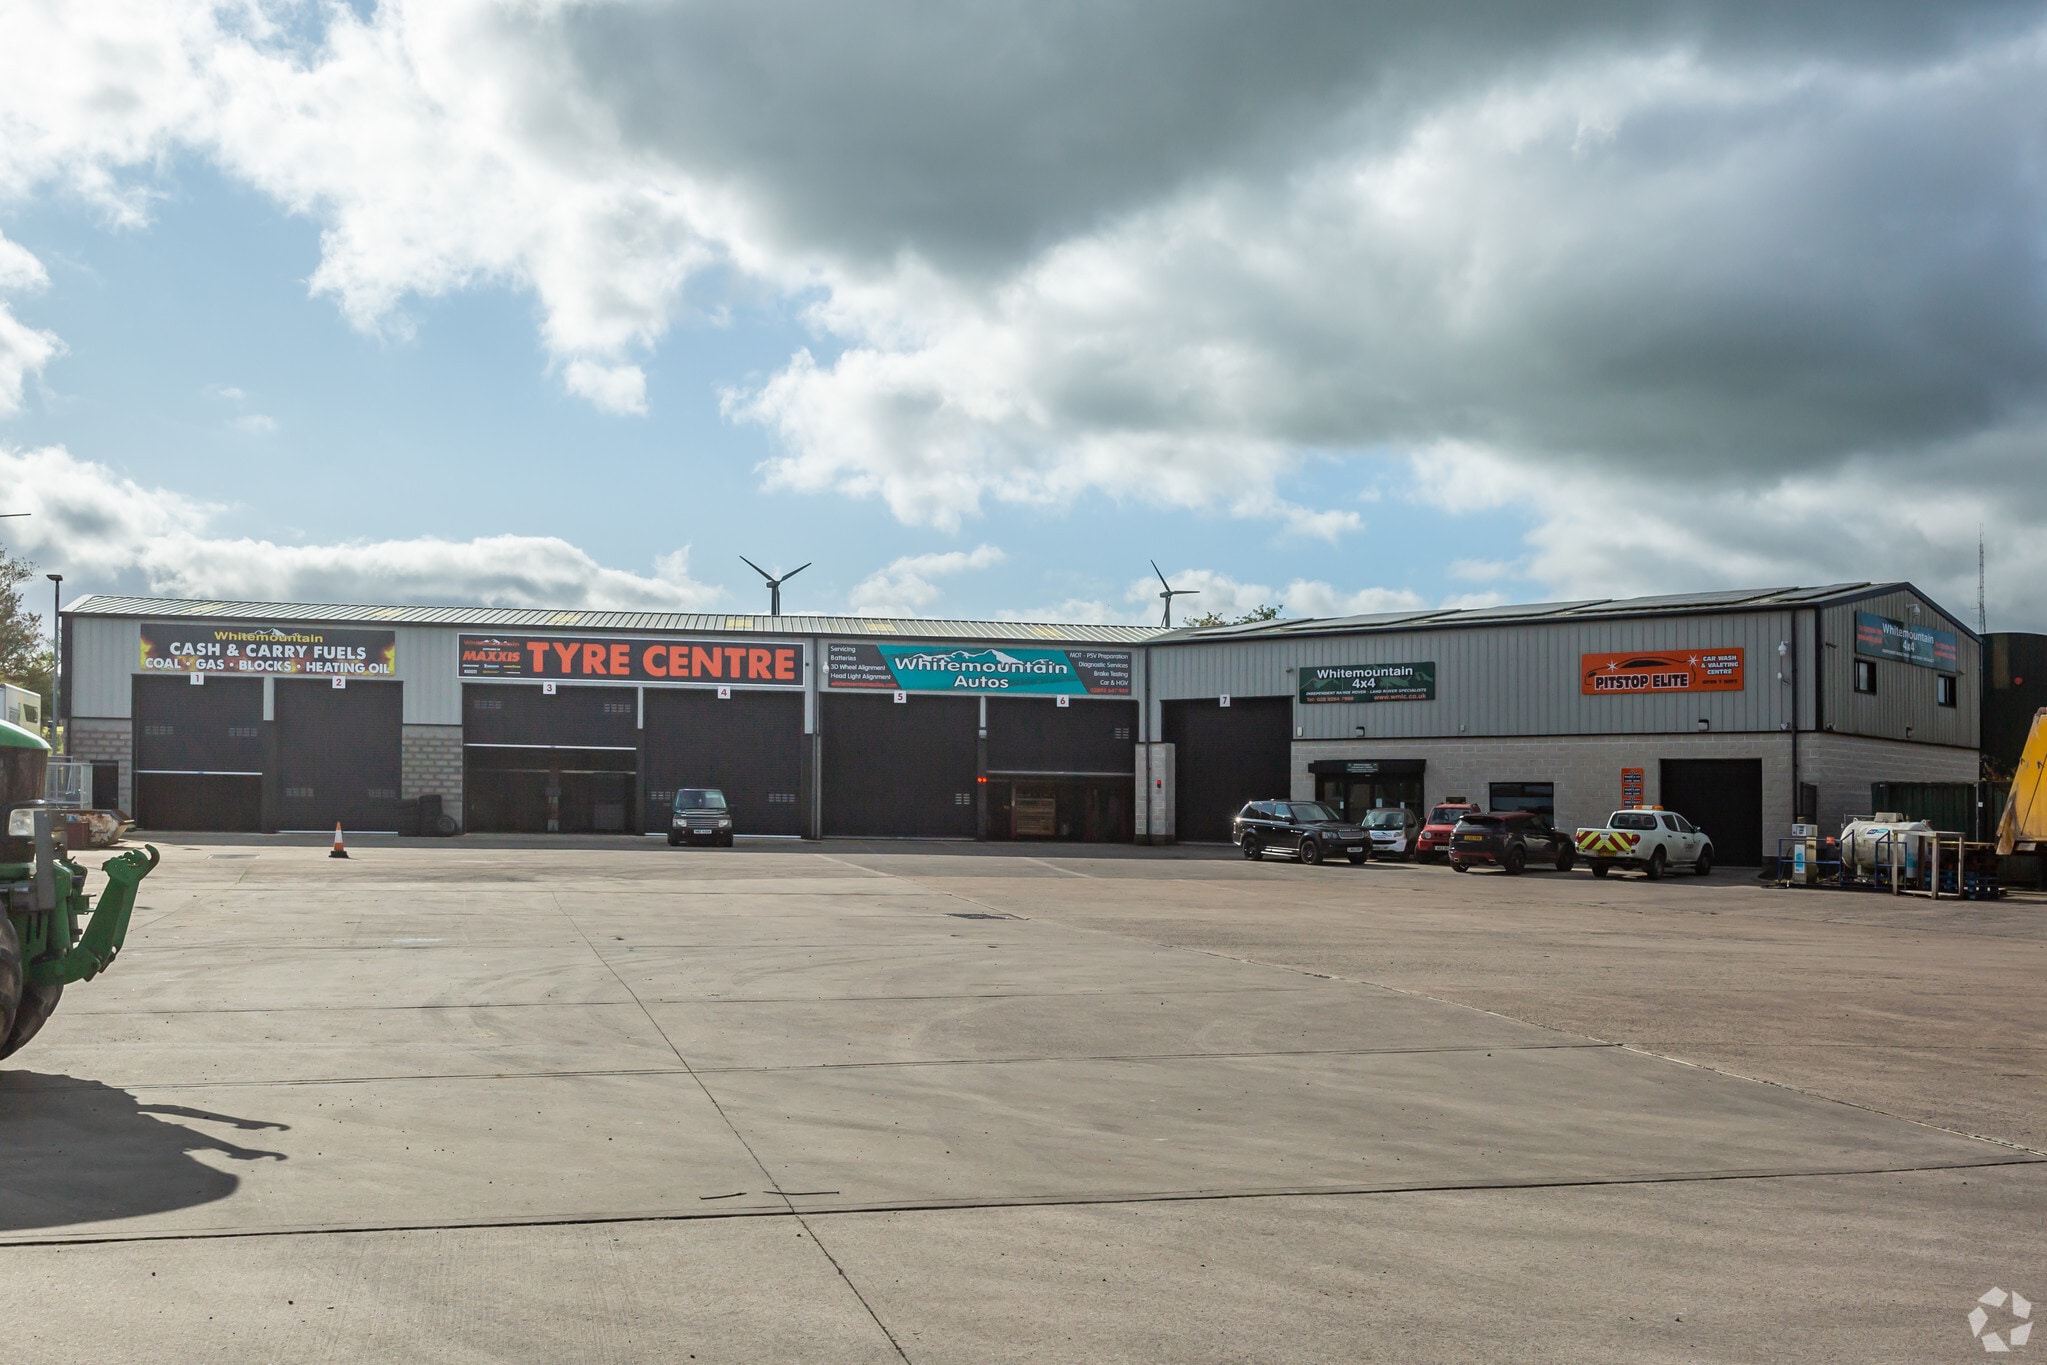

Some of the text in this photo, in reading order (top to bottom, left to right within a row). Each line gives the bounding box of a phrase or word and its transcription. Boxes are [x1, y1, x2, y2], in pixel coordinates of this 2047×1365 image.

[214, 631, 324, 643] Whitemountain
[1882, 623, 1934, 645] Whitemountain
[169, 642, 367, 660] CASH & CARRY FUELS
[830, 645, 856, 653] Servicing
[1902, 640, 1915, 653] 4x4
[462, 650, 521, 662] MAXXIS
[526, 641, 796, 680] TYRE CENTRE
[145, 657, 391, 674] COAL GAS BLOCKS HEATING OIL
[858, 664, 886, 672] Alignment
[894, 657, 1068, 675] Whitemountain
[1078, 661, 1106, 669] Diagnostic
[1317, 666, 1413, 679] Whitemountain
[336, 678, 342, 686] 2
[953, 675, 1009, 689] Autos
[1351, 678, 1376, 689] 4x4
[1595, 673, 1689, 690] PITSTOP ELITE
[546, 684, 553, 692] 3
[720, 688, 728, 697] 4
[897, 693, 903, 701] 5
[1060, 697, 1066, 705] 6
